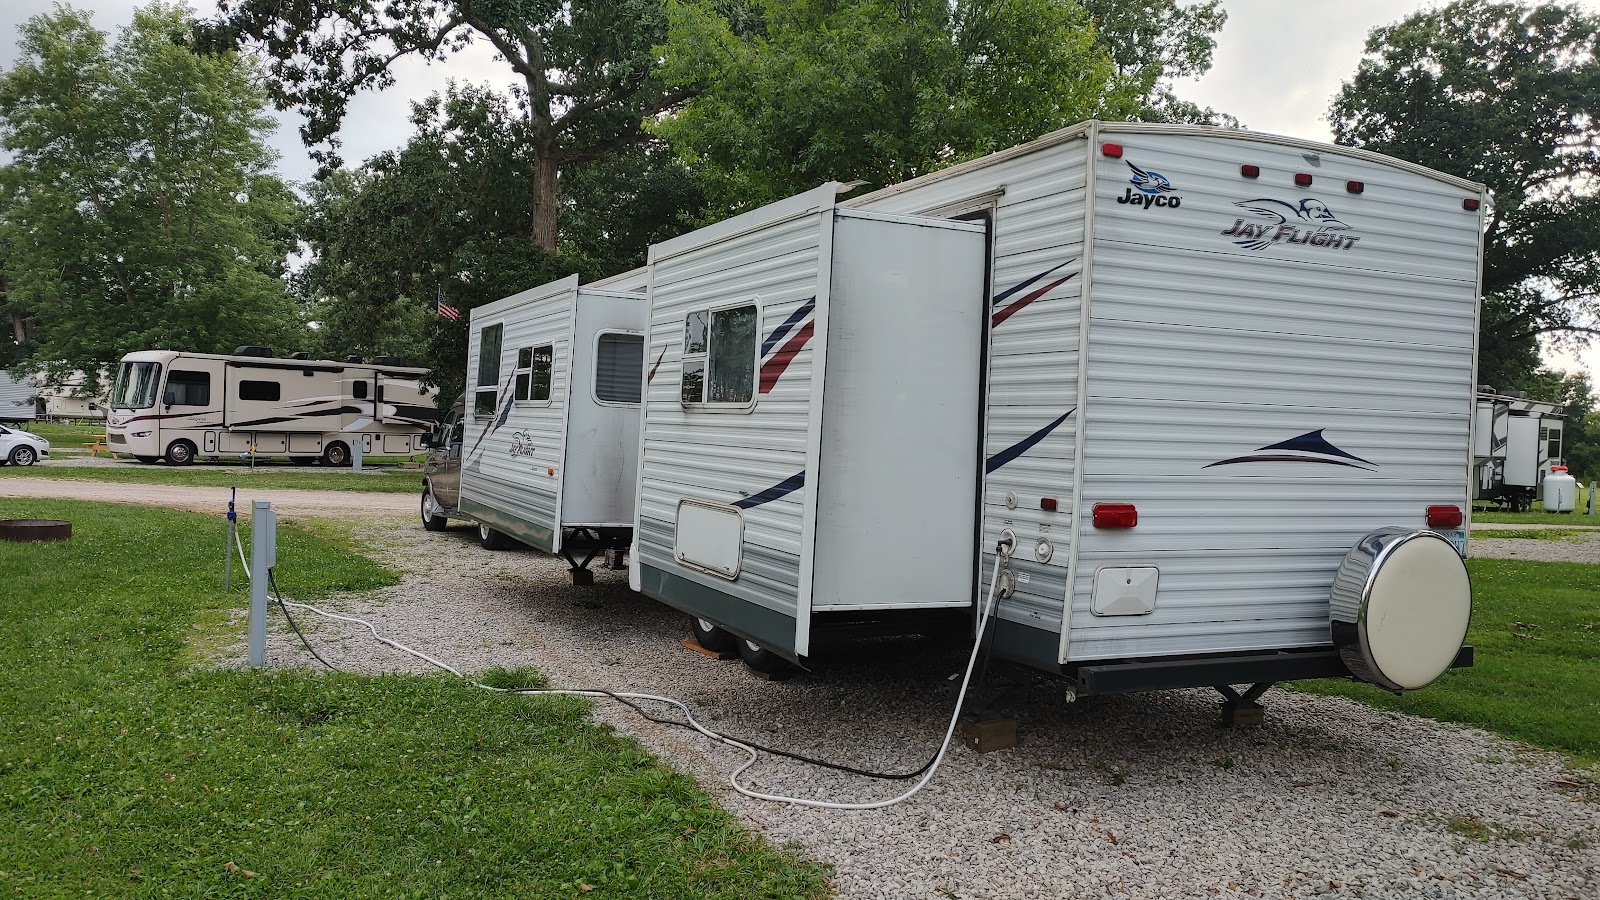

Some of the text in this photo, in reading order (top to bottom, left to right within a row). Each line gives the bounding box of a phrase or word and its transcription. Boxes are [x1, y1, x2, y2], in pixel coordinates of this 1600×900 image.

[1117, 187, 1182, 209] Jayco
[1221, 219, 1361, 251] JAY FLIGHT
